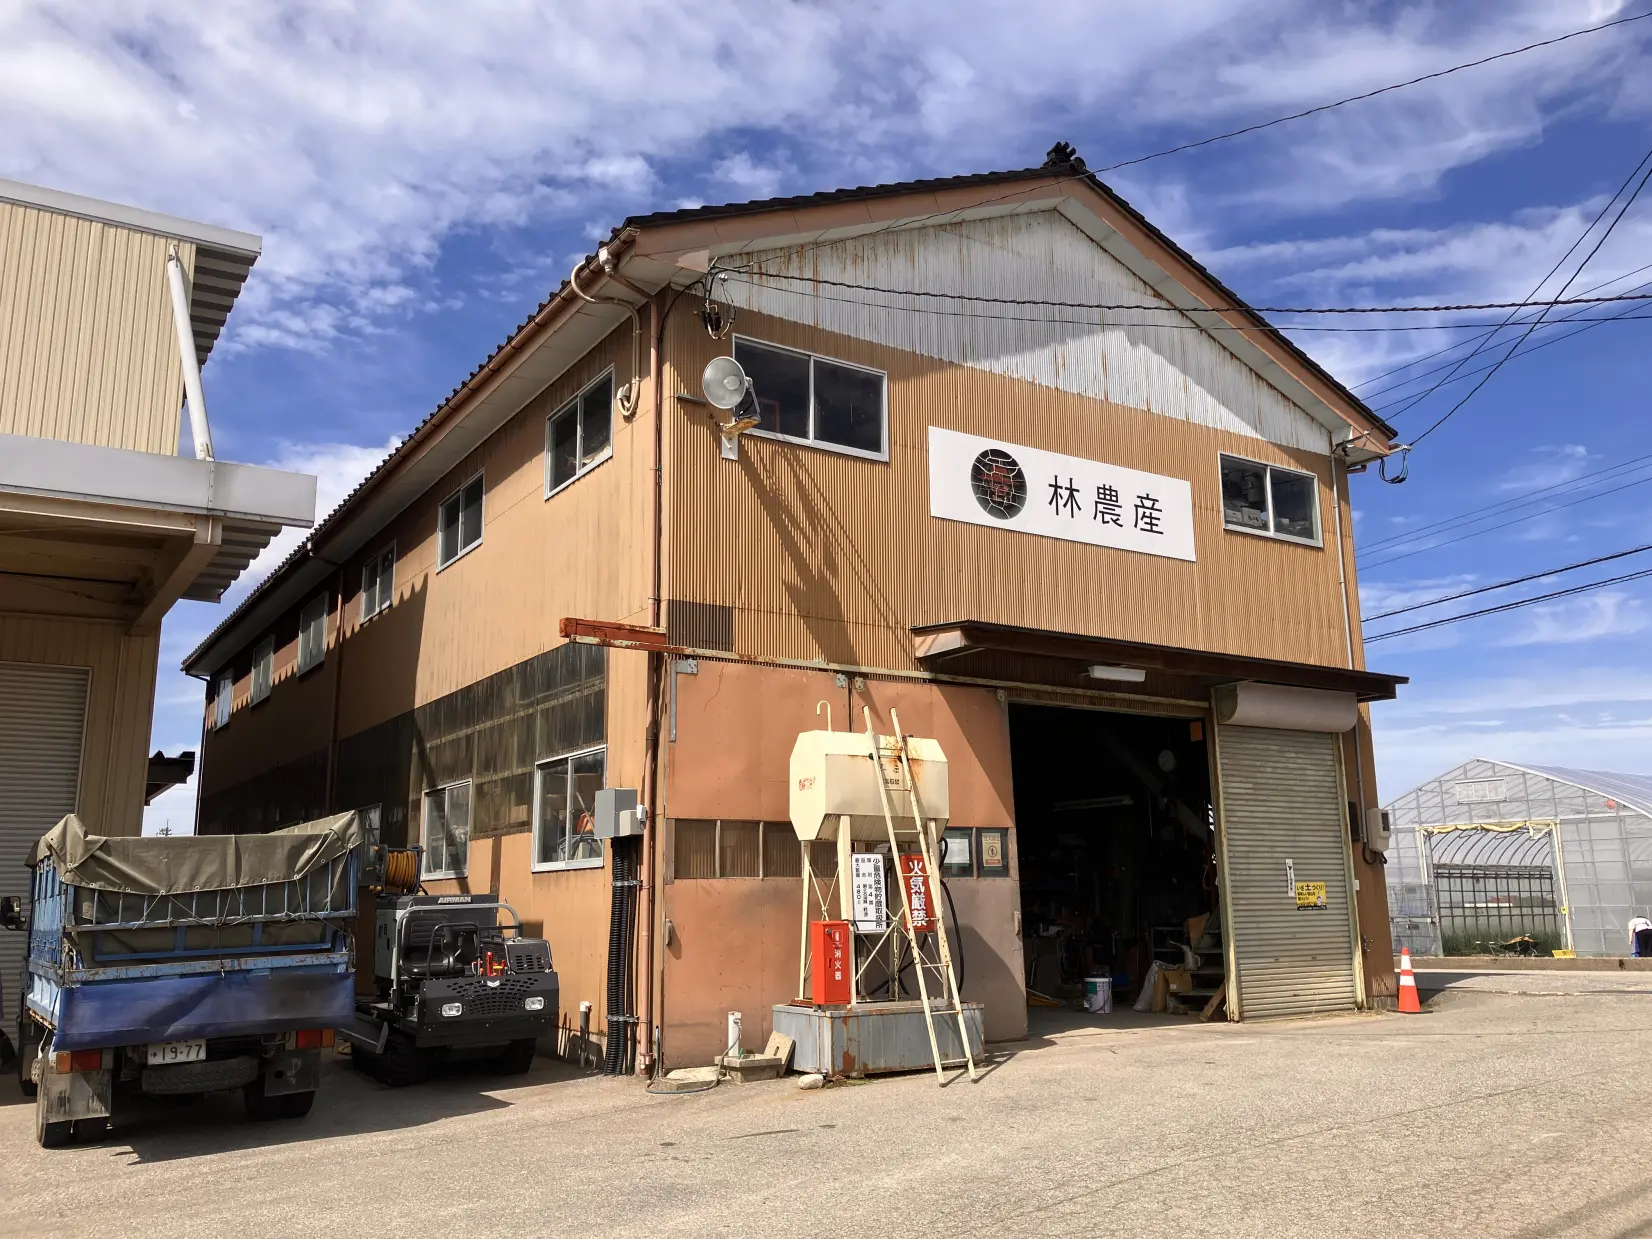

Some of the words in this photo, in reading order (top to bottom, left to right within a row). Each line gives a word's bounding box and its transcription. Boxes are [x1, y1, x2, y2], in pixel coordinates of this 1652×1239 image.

[1048, 474, 1164, 536] 林農産
[437, 896, 471, 904] AIRMAN
[909, 859, 927, 926] 火気厳禁
[834, 949, 842, 981] 消火器
[162, 1044, 203, 1061] 19-77
